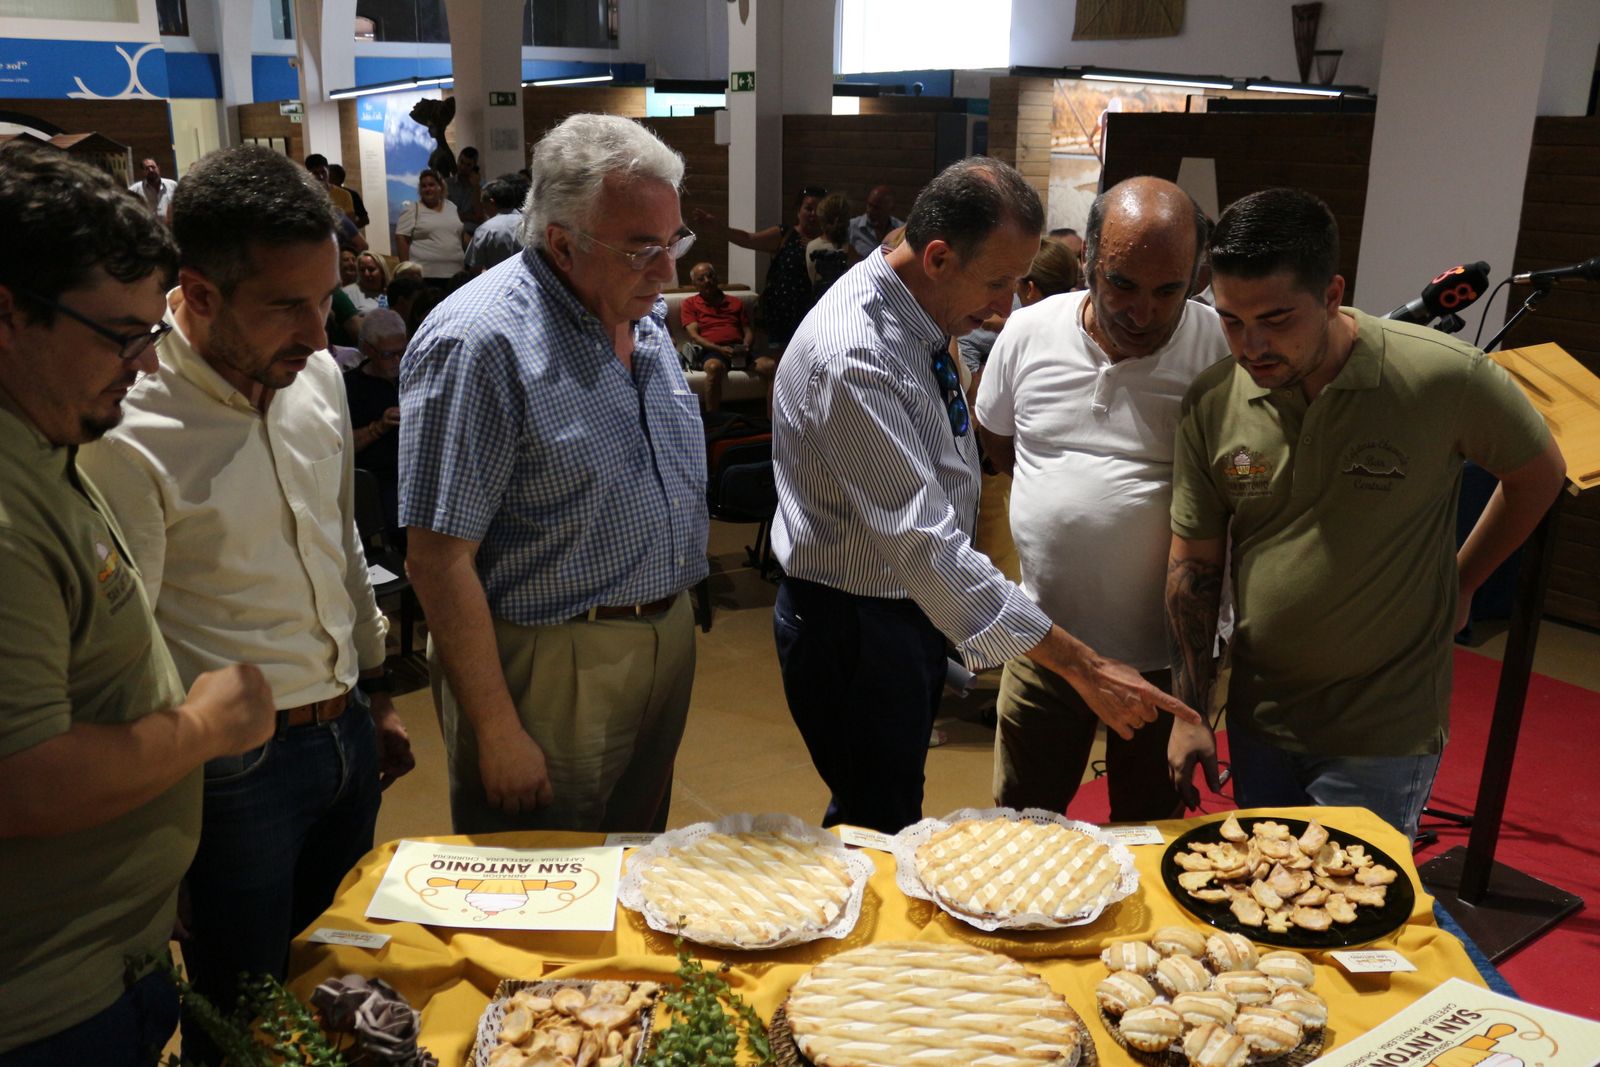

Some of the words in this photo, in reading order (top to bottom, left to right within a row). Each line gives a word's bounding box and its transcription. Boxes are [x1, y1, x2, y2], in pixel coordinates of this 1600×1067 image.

[430, 859, 532, 874] ANTONIO
[538, 863, 583, 874] SAN
[1432, 1008, 1482, 1035] SAN
[1364, 1030, 1444, 1067] ANTON
[1419, 1040, 1454, 1061] OBRADOR
